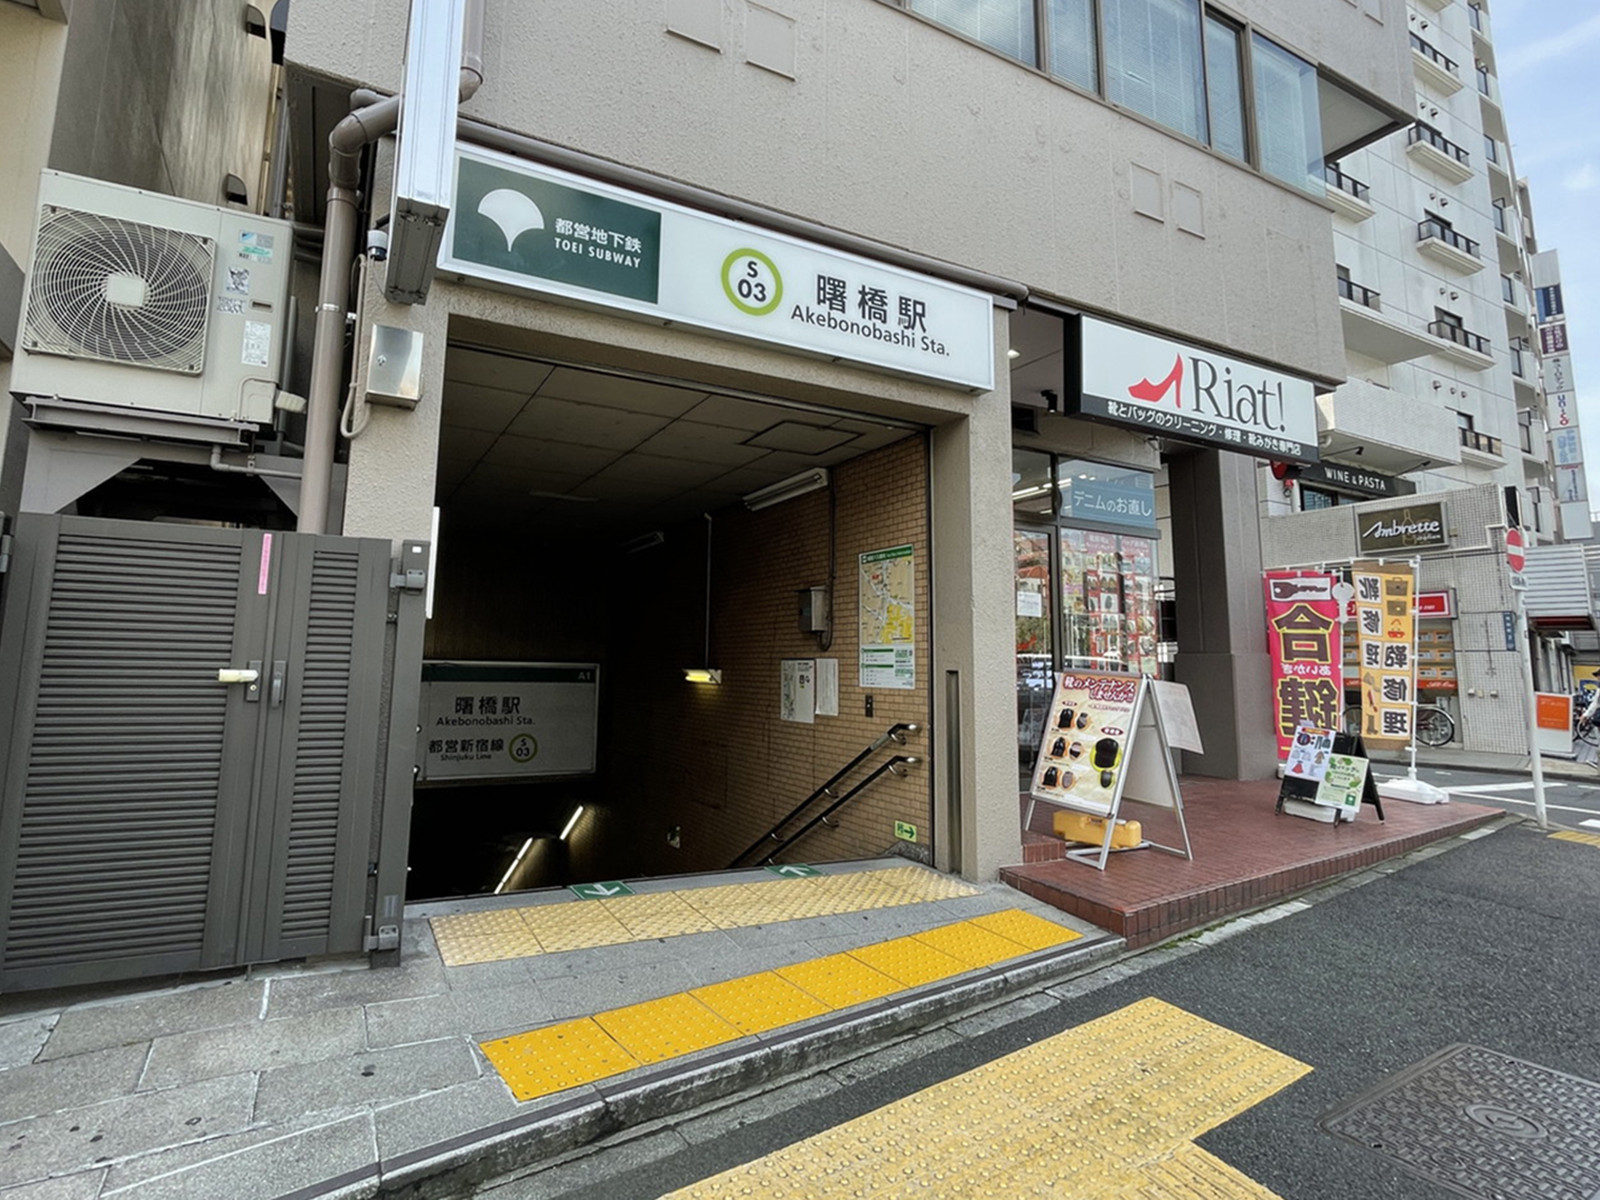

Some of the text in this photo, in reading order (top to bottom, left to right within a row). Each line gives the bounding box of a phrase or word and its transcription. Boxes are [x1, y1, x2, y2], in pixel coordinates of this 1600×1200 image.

[555, 218, 642, 253] 都営地下鉄
[554, 237, 640, 268] TOEI SUBWAY
[746, 260, 759, 279] S
[737, 278, 767, 303] 03
[816, 274, 927, 334] 曙橋駅
[791, 305, 950, 357] Akebonobashi Sta.
[1188, 355, 1286, 433] Riat!
[1324, 467, 1387, 491] WINE & PASTA
[1073, 488, 1152, 517] デニムのお直し
[578, 671, 592, 681] A1
[455, 696, 522, 715] 曙橋駅
[436, 716, 537, 727] Akebonobashi Sta.
[428, 738, 505, 754] 都営新宿線
[515, 747, 531, 758] 03
[520, 738, 527, 747] S
